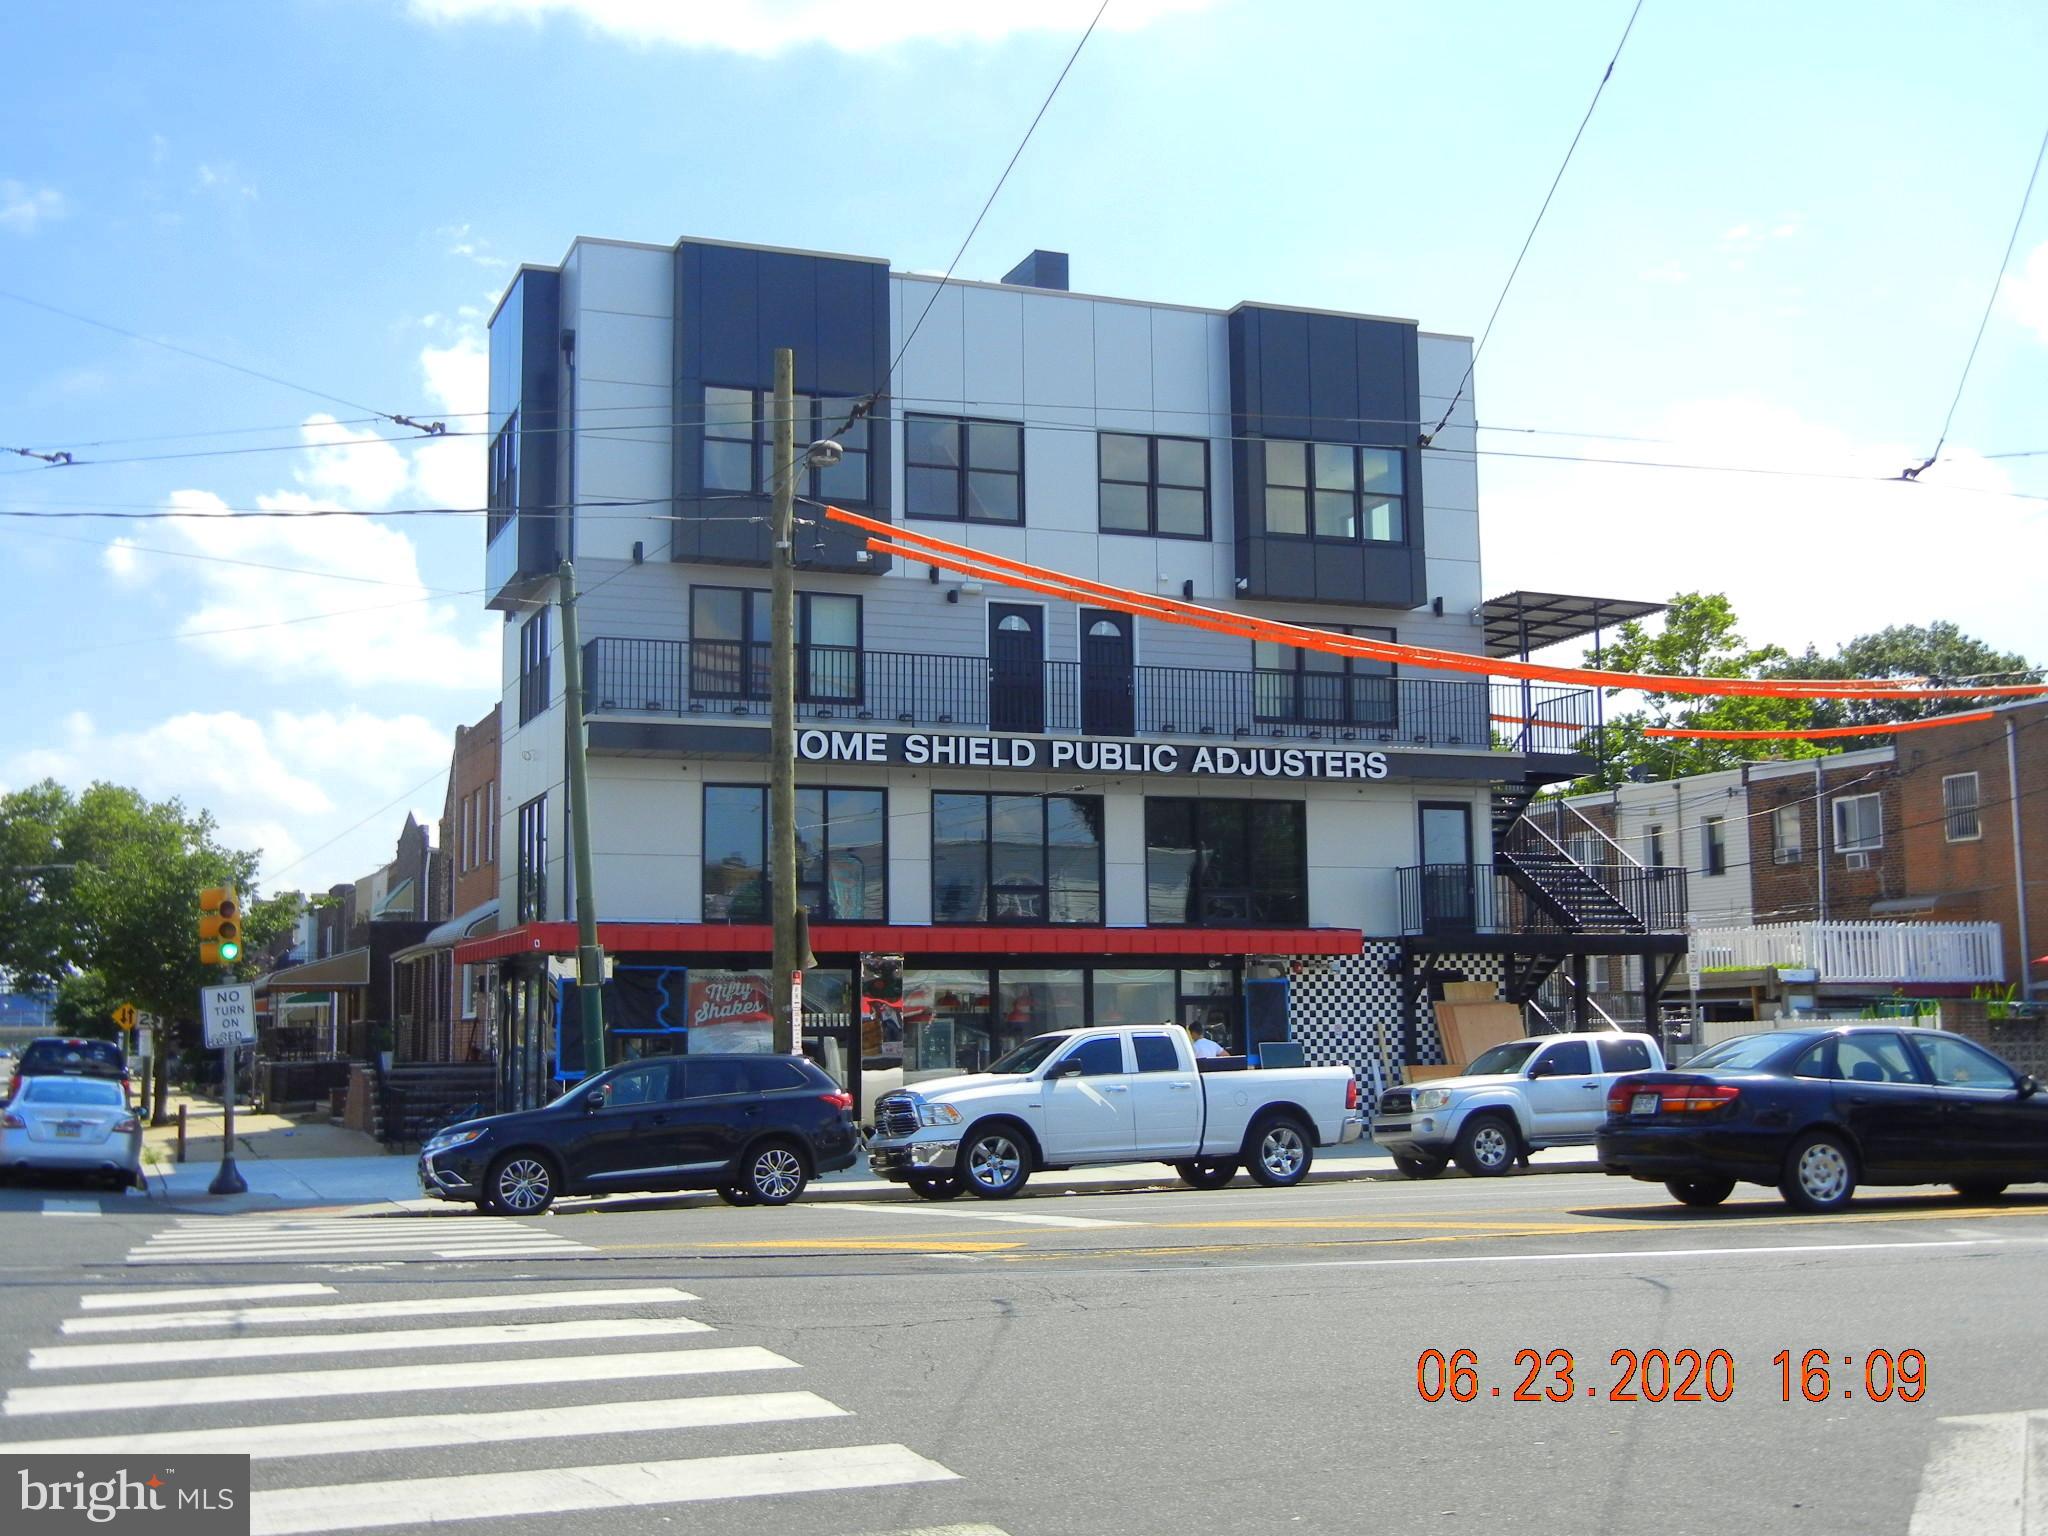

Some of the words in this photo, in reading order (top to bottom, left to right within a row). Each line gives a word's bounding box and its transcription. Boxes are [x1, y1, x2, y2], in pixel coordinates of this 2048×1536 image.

[793, 731, 888, 762] OME
[905, 735, 1036, 767] SHIELD
[1052, 741, 1178, 773] PUBLIC
[1191, 747, 1388, 778] ADJUSTERS
[216, 991, 240, 1003] NO
[706, 981, 752, 1001] Nifty
[215, 1005, 245, 1016] TURN
[695, 1001, 763, 1026] Shakes
[222, 1018, 239, 1028] ON
